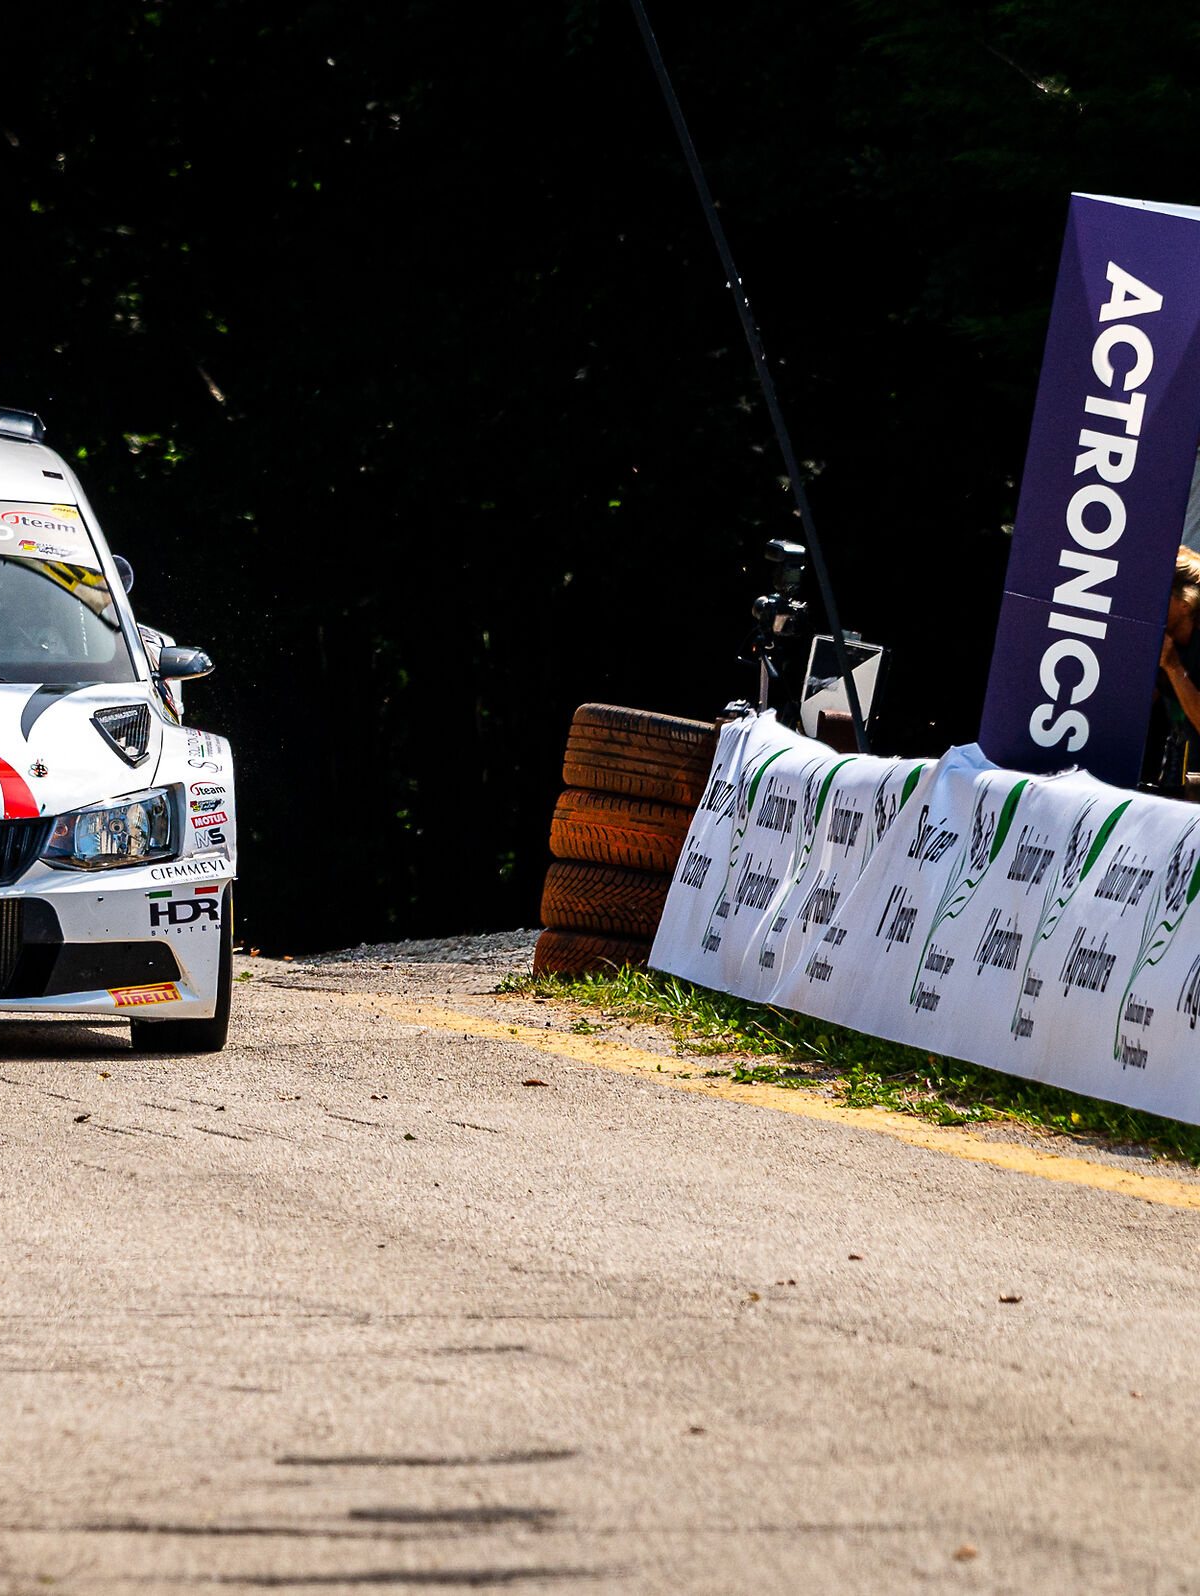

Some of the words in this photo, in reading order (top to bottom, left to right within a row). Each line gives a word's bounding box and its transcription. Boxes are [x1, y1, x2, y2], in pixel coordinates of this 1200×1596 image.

[1029, 260, 1163, 752] ACTRONICS
[194, 814, 227, 827] MOTUL
[195, 827, 226, 848] MS
[150, 860, 225, 880] CIEMMEVI
[149, 898, 220, 926] HDR
[151, 924, 221, 936] SYSTEM
[110, 983, 179, 1006] PIRELLI
